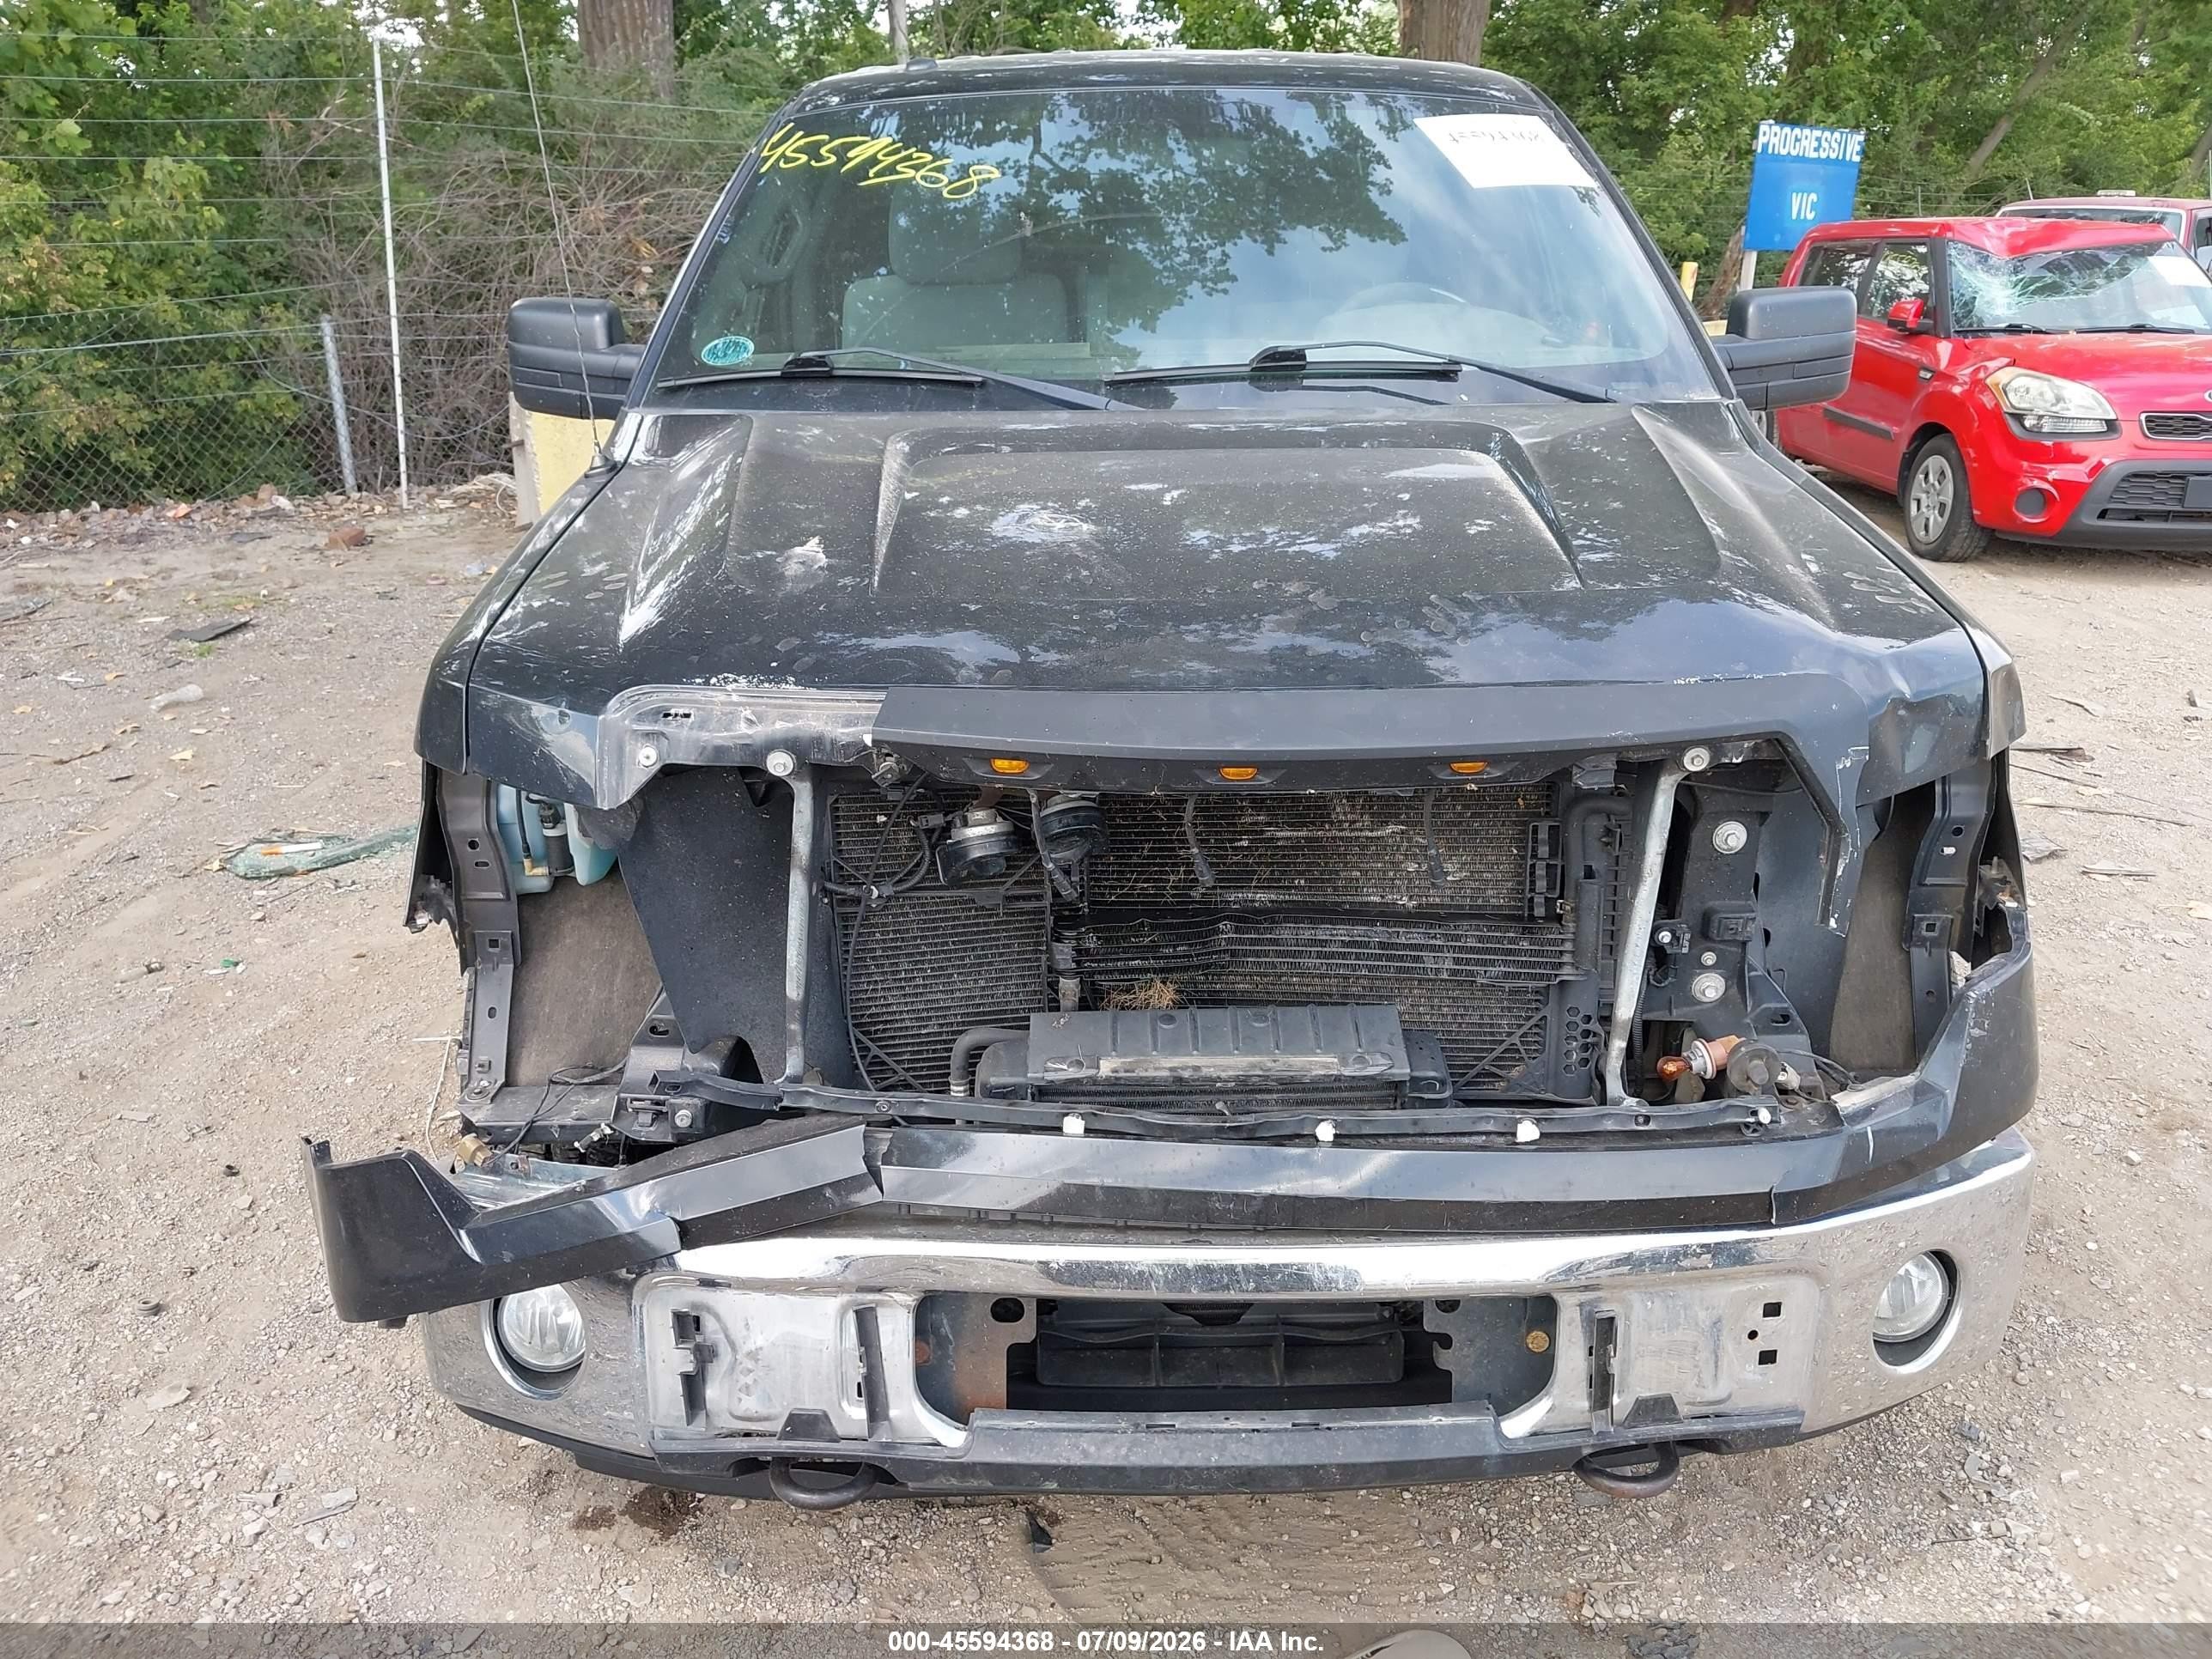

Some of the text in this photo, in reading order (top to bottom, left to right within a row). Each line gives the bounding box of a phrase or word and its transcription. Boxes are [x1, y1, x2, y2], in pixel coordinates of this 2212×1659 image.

[759, 122, 1001, 198] 45594368
[1757, 124, 1865, 163] PROGRESSIVE
[1791, 191, 1818, 221] VIC
